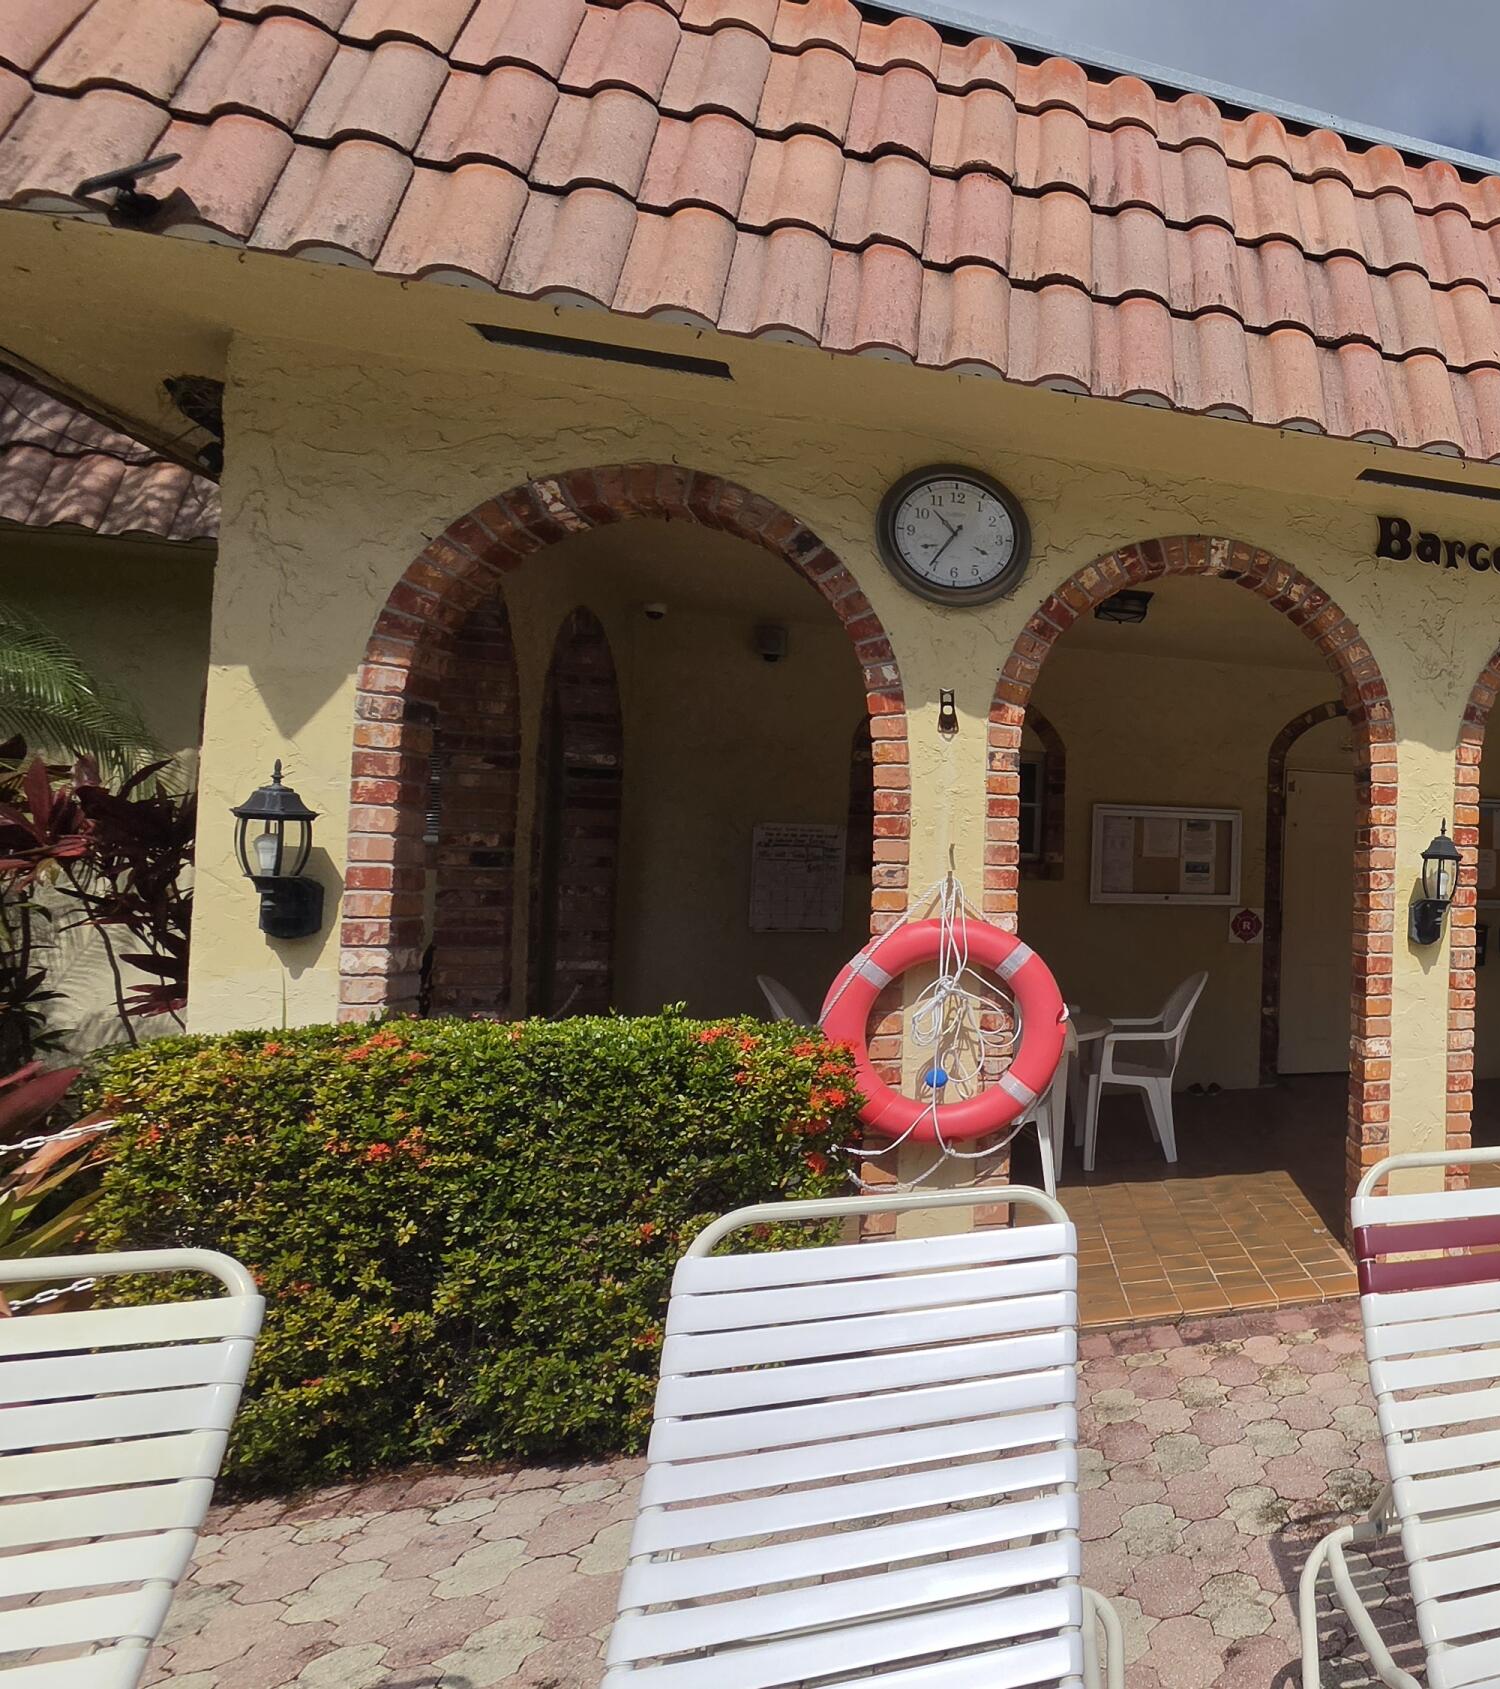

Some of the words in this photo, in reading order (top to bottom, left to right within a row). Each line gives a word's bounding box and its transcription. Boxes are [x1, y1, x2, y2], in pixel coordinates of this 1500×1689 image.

[930, 494, 944, 507] 11
[951, 492, 966, 504] 12
[976, 501, 983, 512] 1
[915, 508, 930, 520] 10
[988, 516, 996, 527] 2
[906, 524, 915, 536] 9
[995, 535, 1004, 546] 3
[950, 567, 958, 578] 6
[971, 564, 979, 576] 5
[1242, 920, 1251, 930] R
